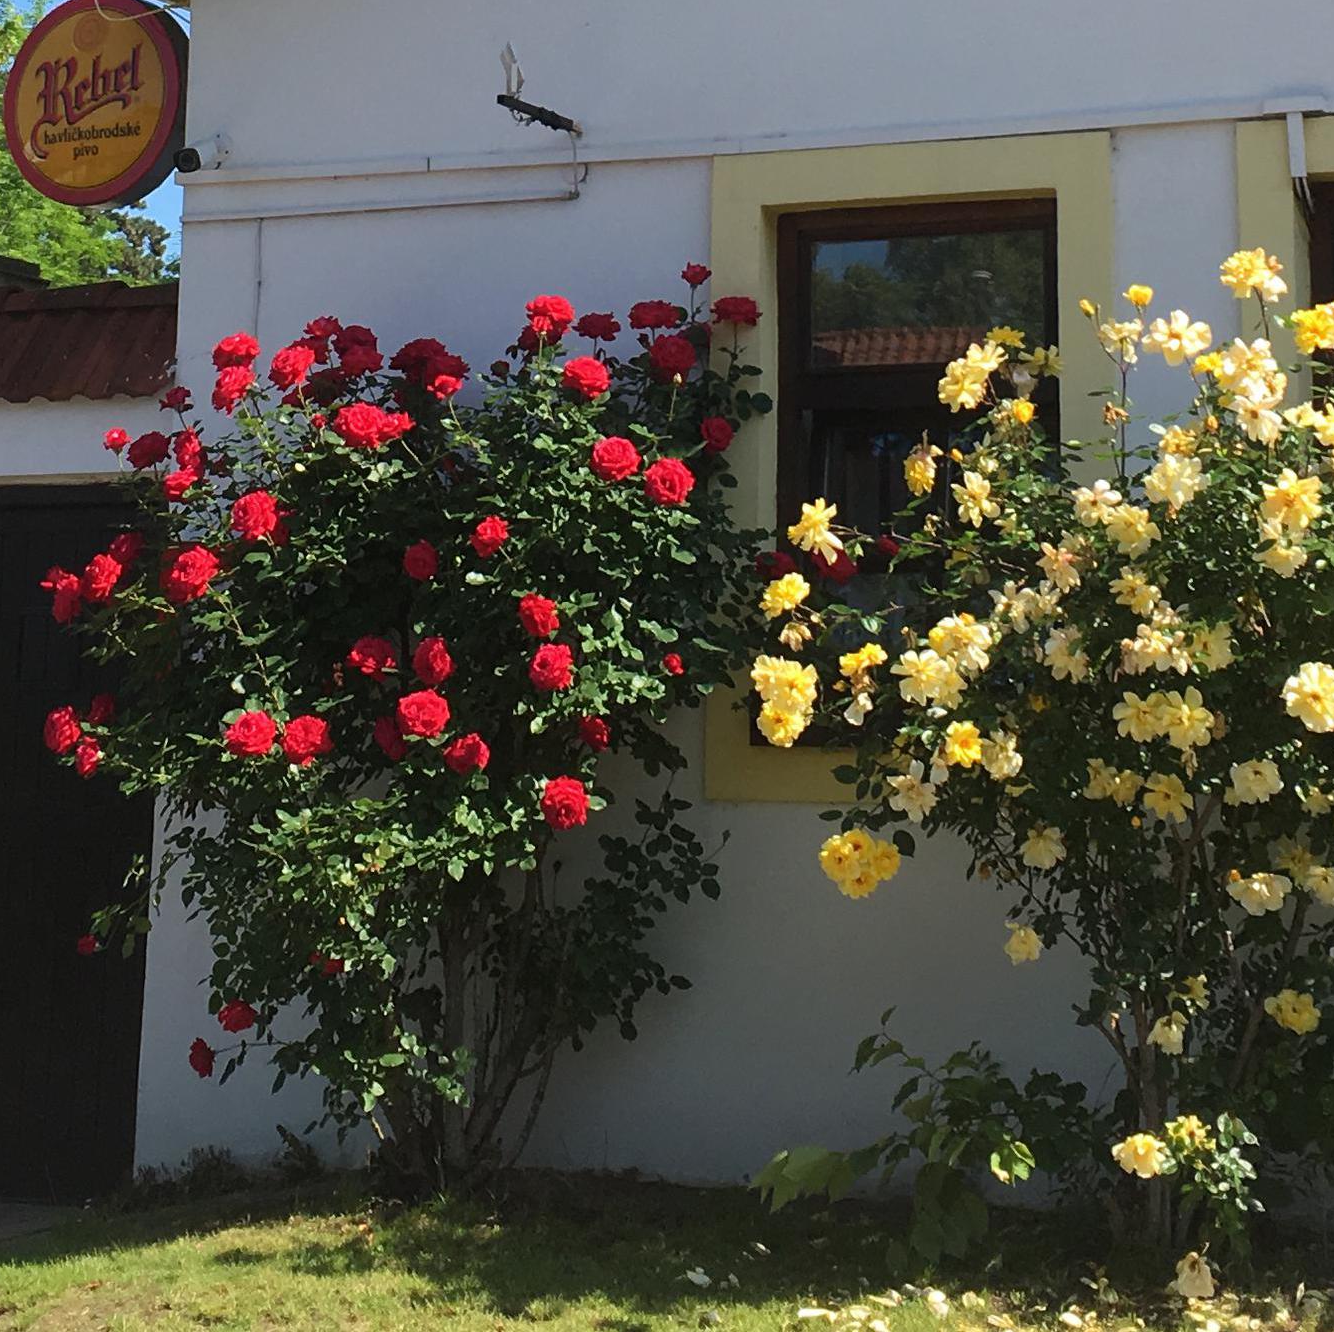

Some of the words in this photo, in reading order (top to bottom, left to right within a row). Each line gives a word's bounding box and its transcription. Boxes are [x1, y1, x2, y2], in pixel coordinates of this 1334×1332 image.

[31, 42, 145, 158] Rebel
[44, 121, 141, 145] havlíčkobrodské
[73, 144, 99, 160] pivo
